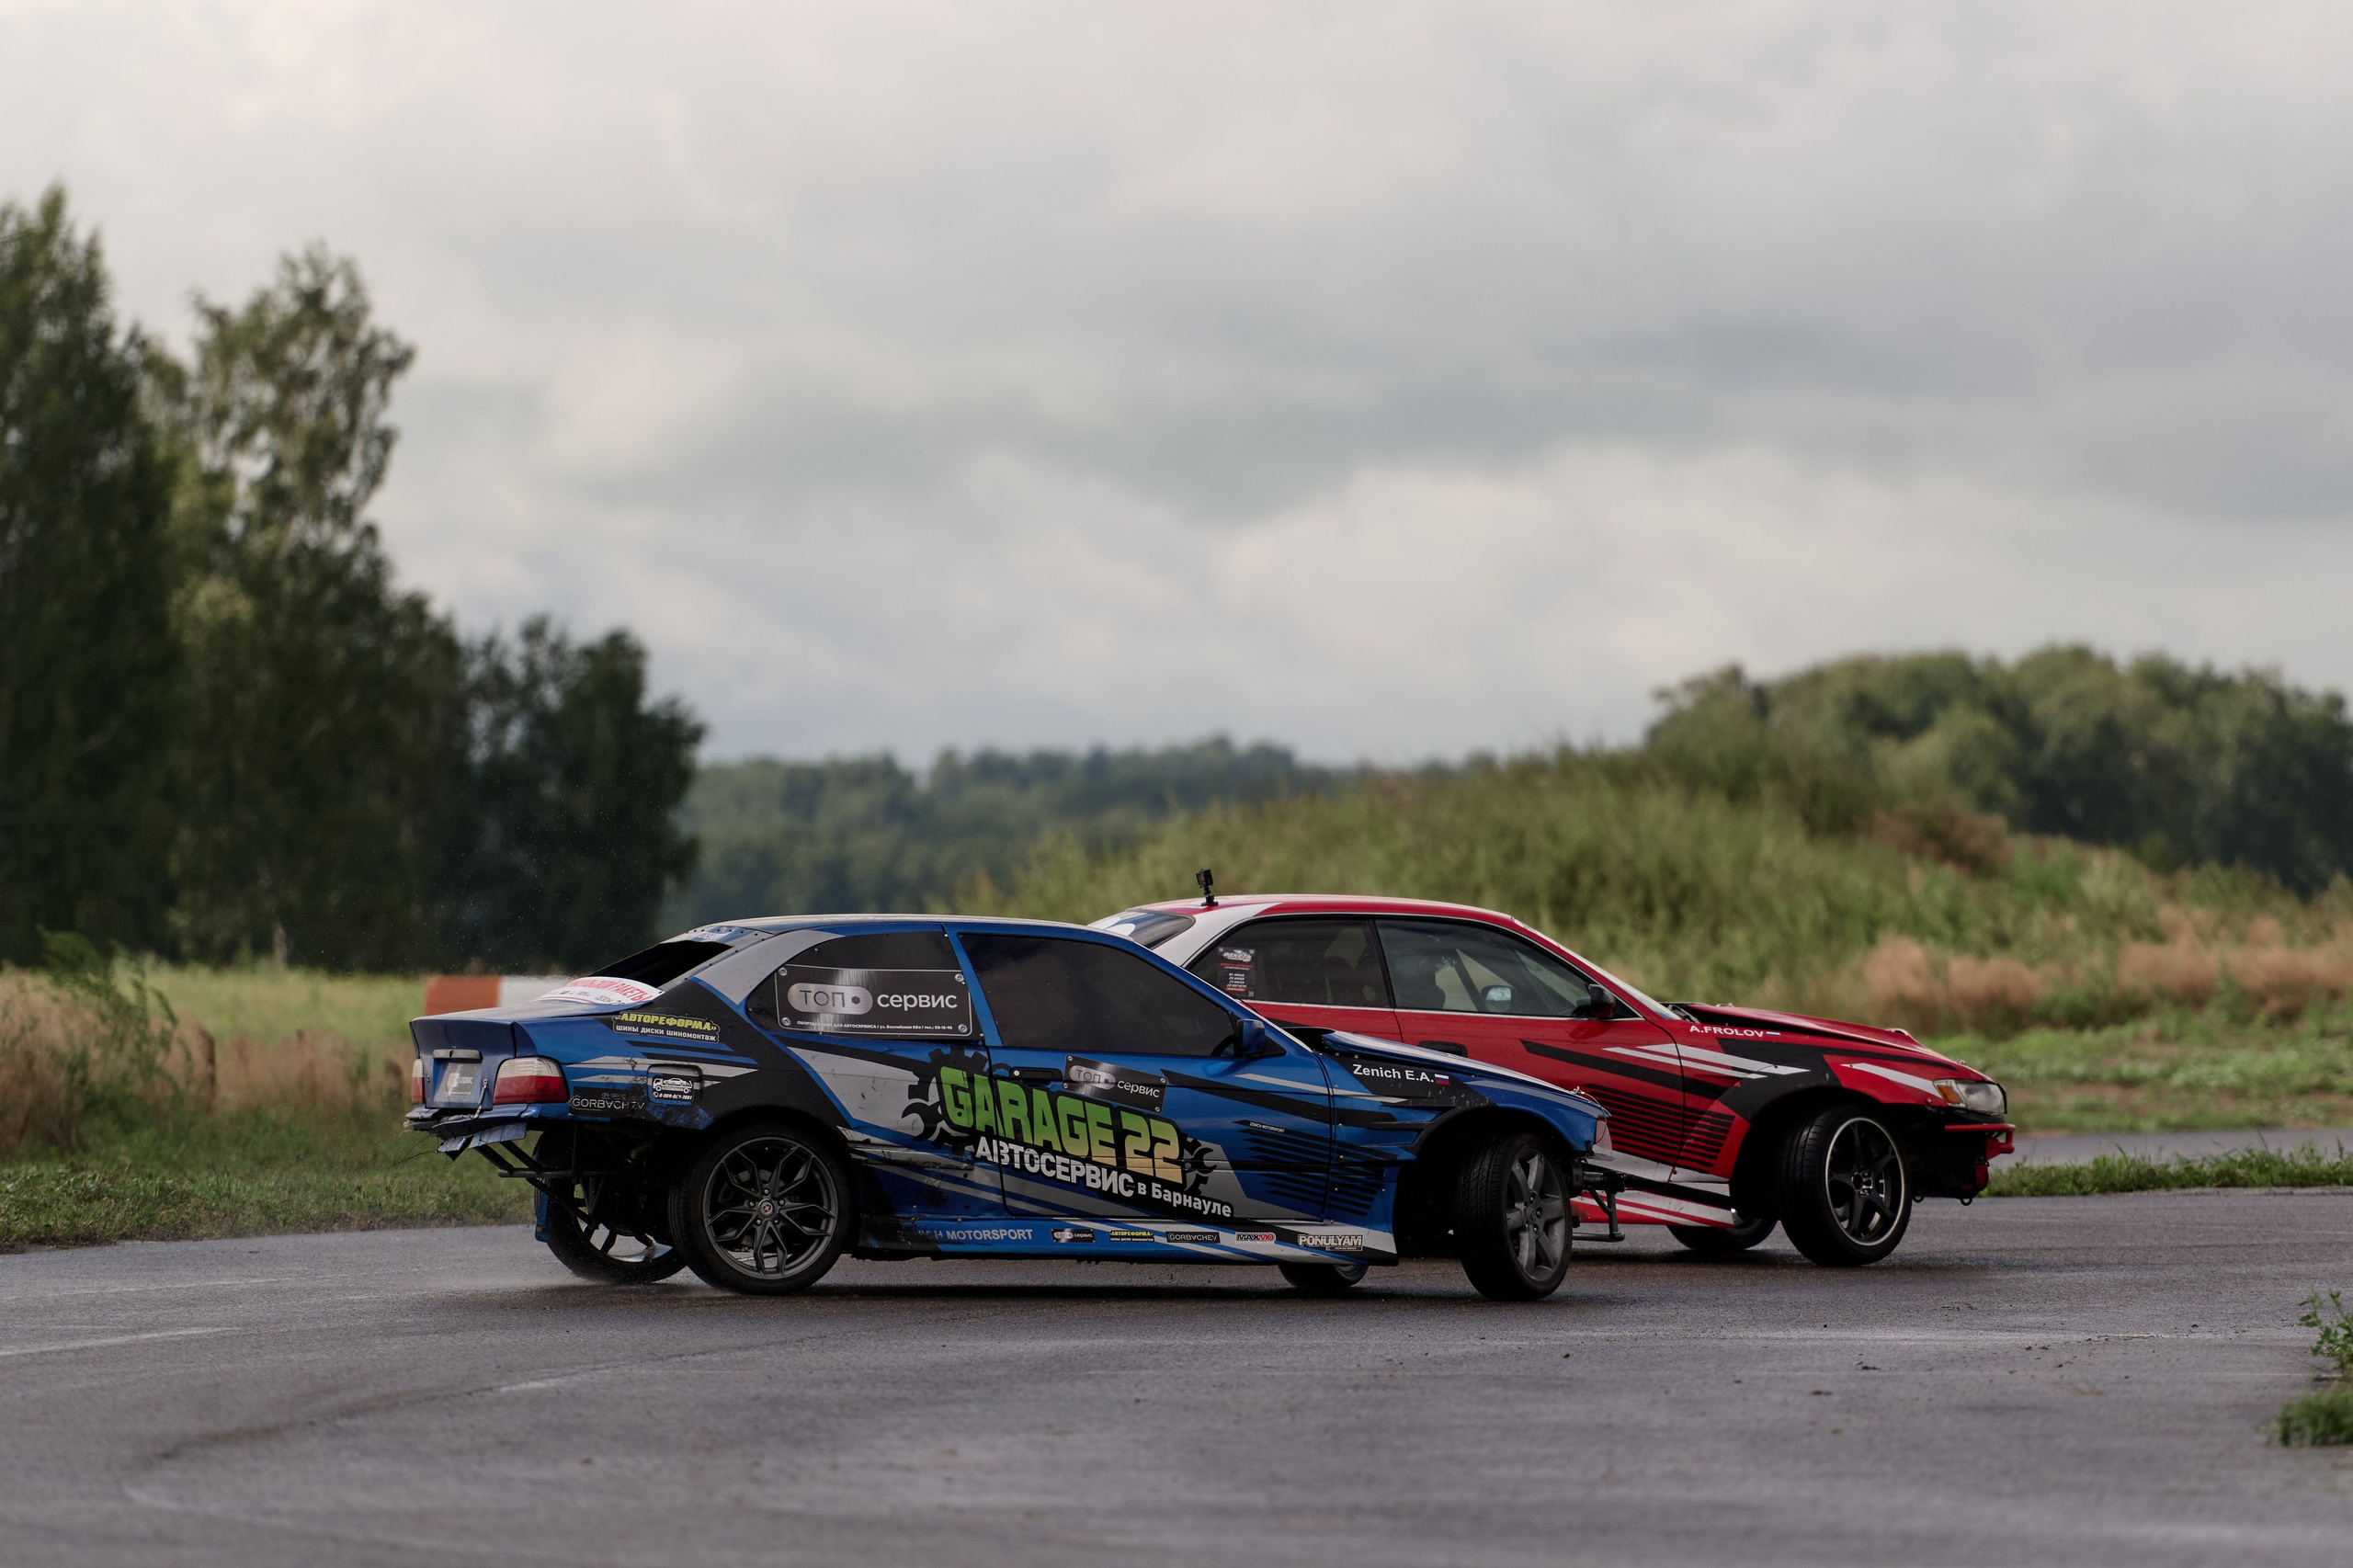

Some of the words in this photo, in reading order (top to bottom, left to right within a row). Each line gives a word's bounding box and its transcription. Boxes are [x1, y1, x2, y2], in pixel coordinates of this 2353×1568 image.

[800, 989, 846, 1008] ТОП
[877, 993, 958, 1011] сервис
[1689, 1025, 1764, 1038] A.FROLOV
[1076, 1069, 1101, 1084] ТОП
[1117, 1080, 1160, 1098] сервис
[1353, 1063, 1402, 1079] Zenich
[1404, 1069, 1434, 1083] E.A.
[940, 1065, 1118, 1167] GARAGE
[1120, 1110, 1183, 1184] 22
[975, 1136, 1135, 1198] АВТОСЕРВИС
[1137, 1182, 1147, 1196] в
[1151, 1183, 1232, 1217] Барнауле
[946, 1229, 1033, 1241] MOTORSPORT
[1299, 1235, 1362, 1246] PONULYAM
